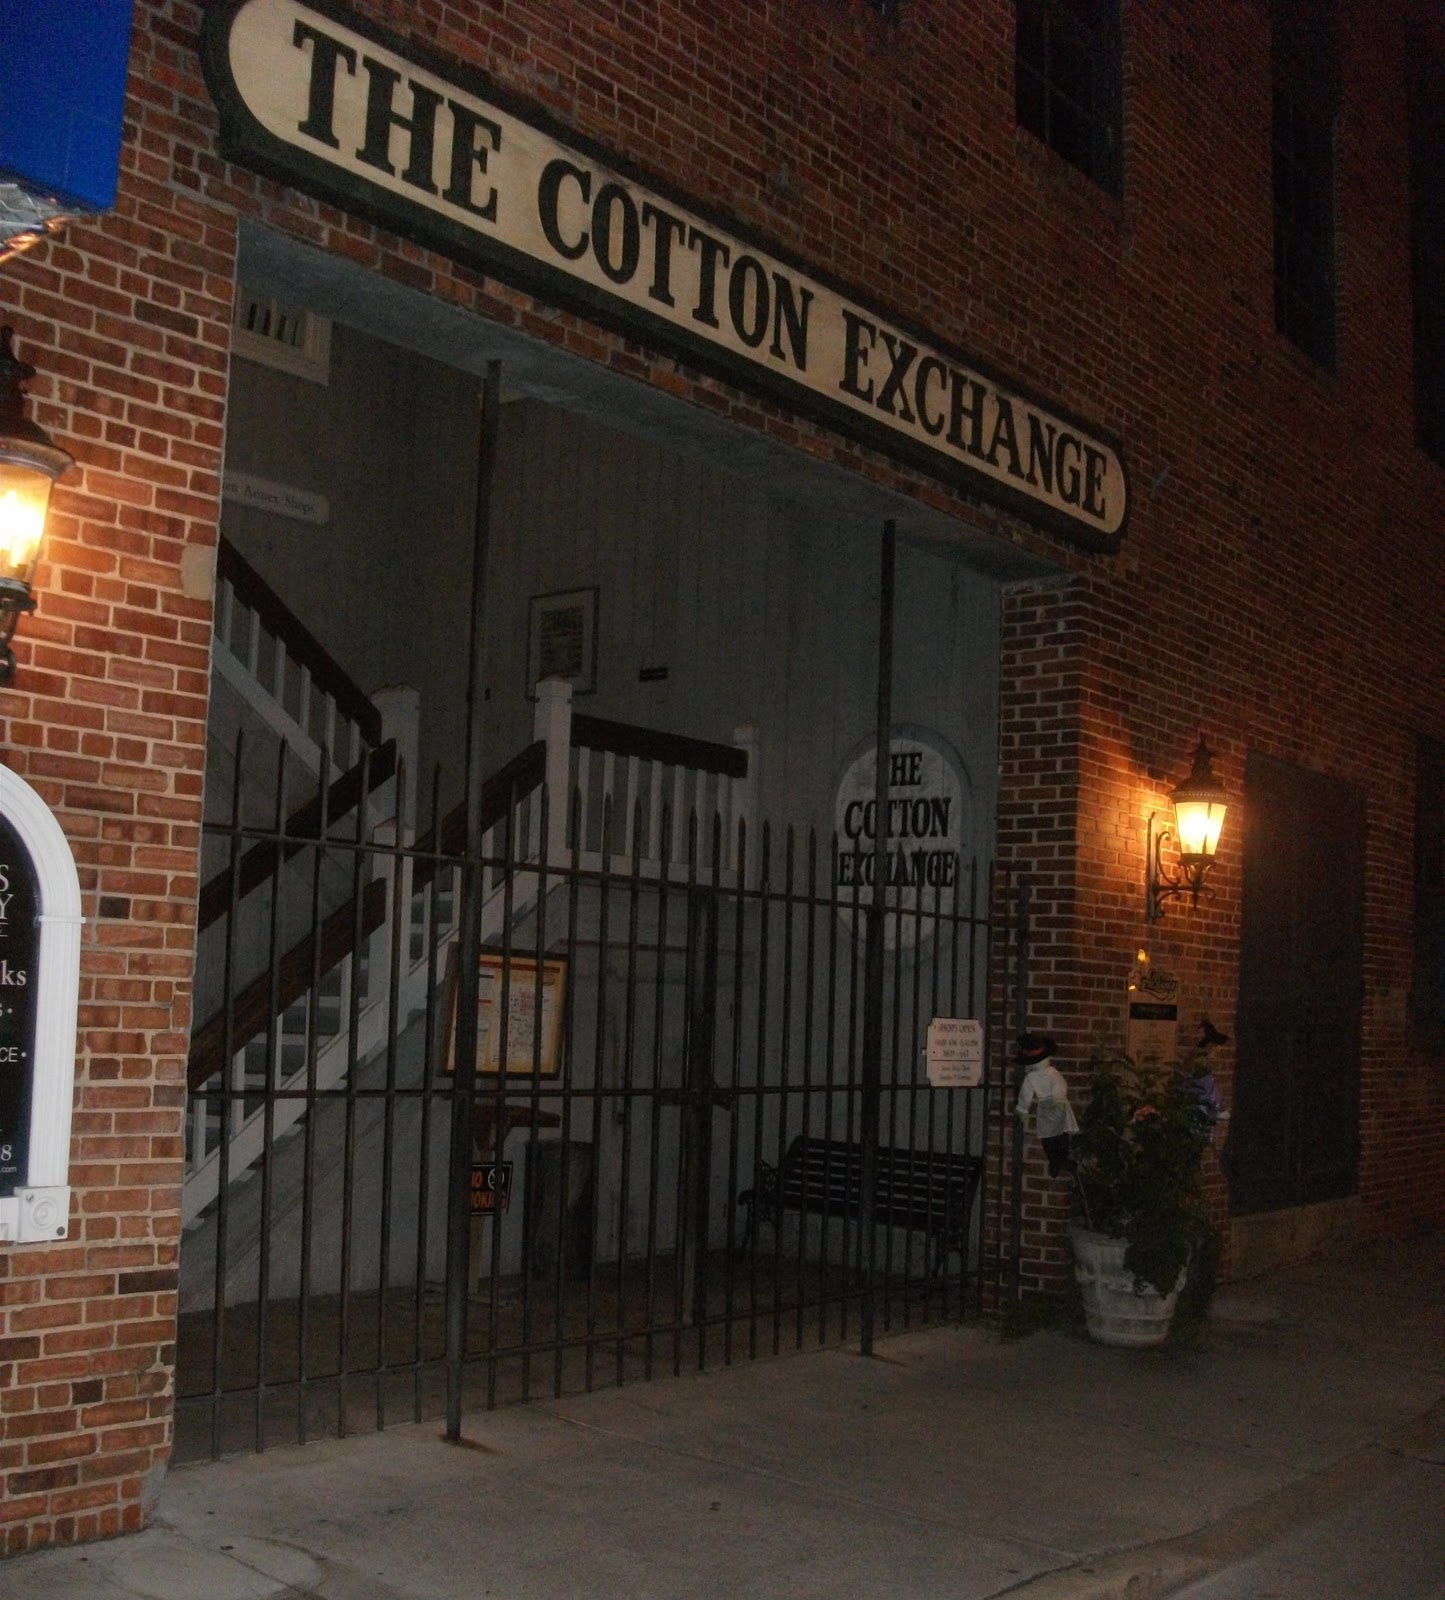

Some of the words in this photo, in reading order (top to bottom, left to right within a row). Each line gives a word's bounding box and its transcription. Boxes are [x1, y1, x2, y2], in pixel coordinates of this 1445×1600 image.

[292, 18, 502, 224] THE
[537, 158, 814, 372] COTTON
[839, 308, 1107, 520] EXCHANGE
[888, 752, 923, 786] HE
